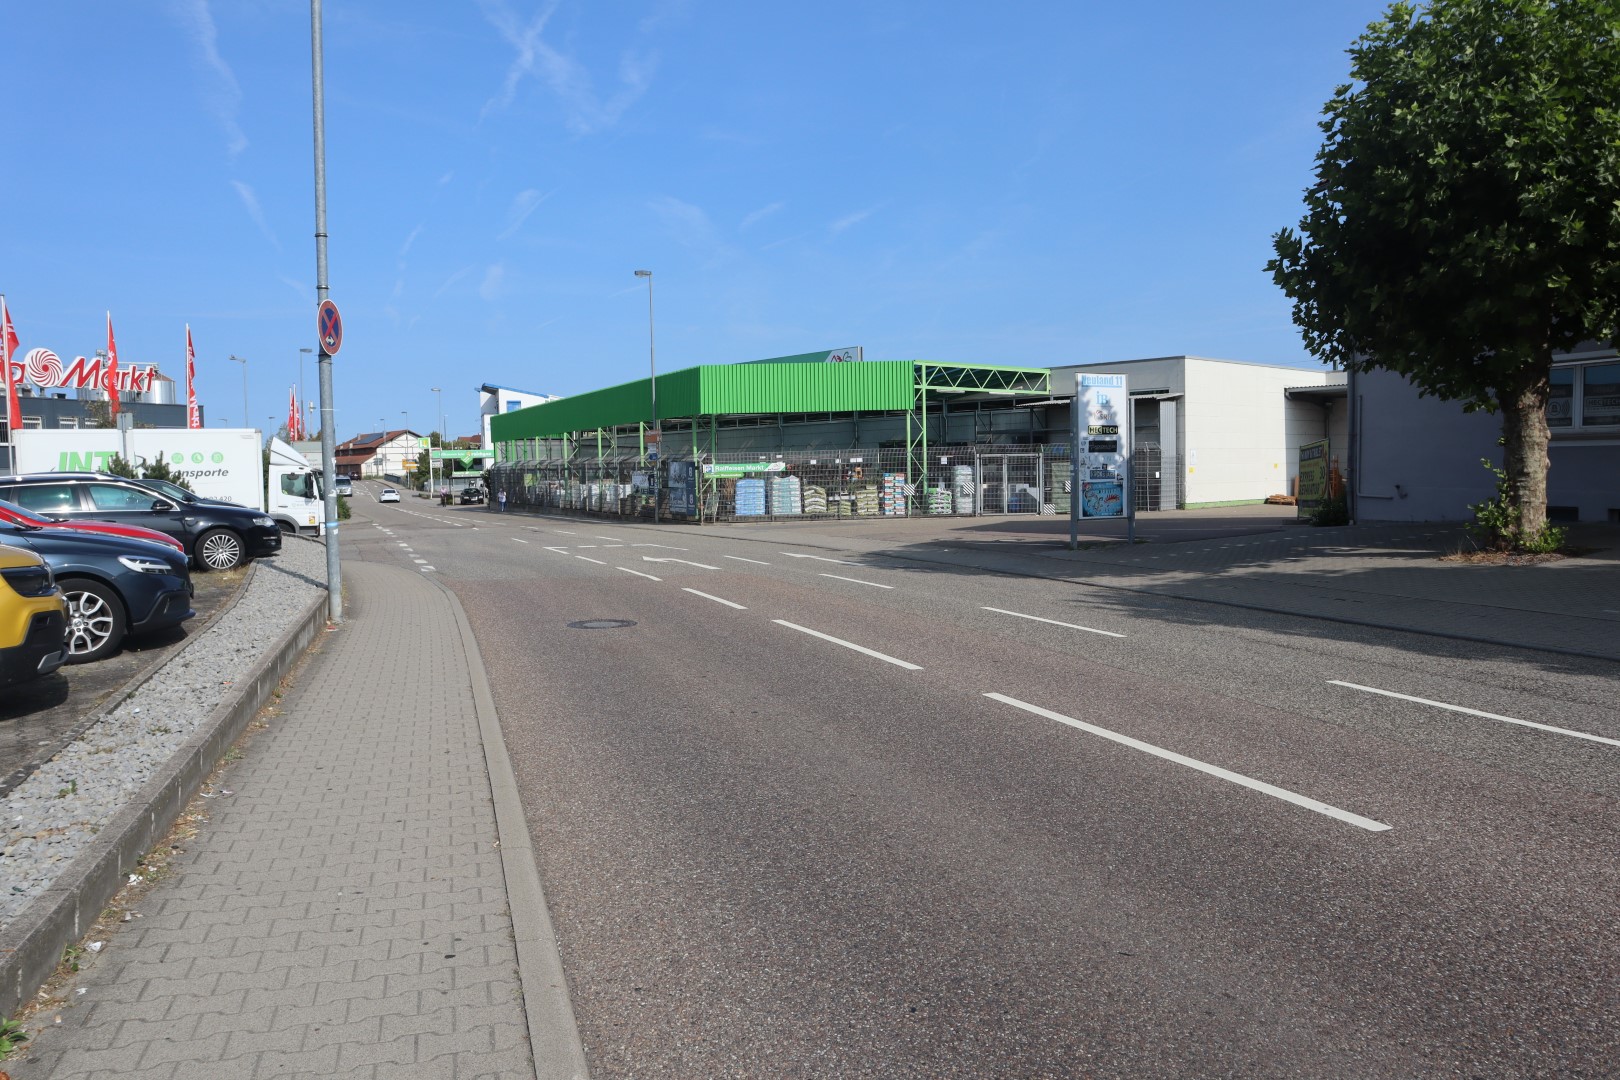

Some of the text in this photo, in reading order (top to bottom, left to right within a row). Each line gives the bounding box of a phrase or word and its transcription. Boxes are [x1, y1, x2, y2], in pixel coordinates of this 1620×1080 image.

[1081, 375, 1122, 386] Neuland 11
[169, 468, 229, 480] ransporte
